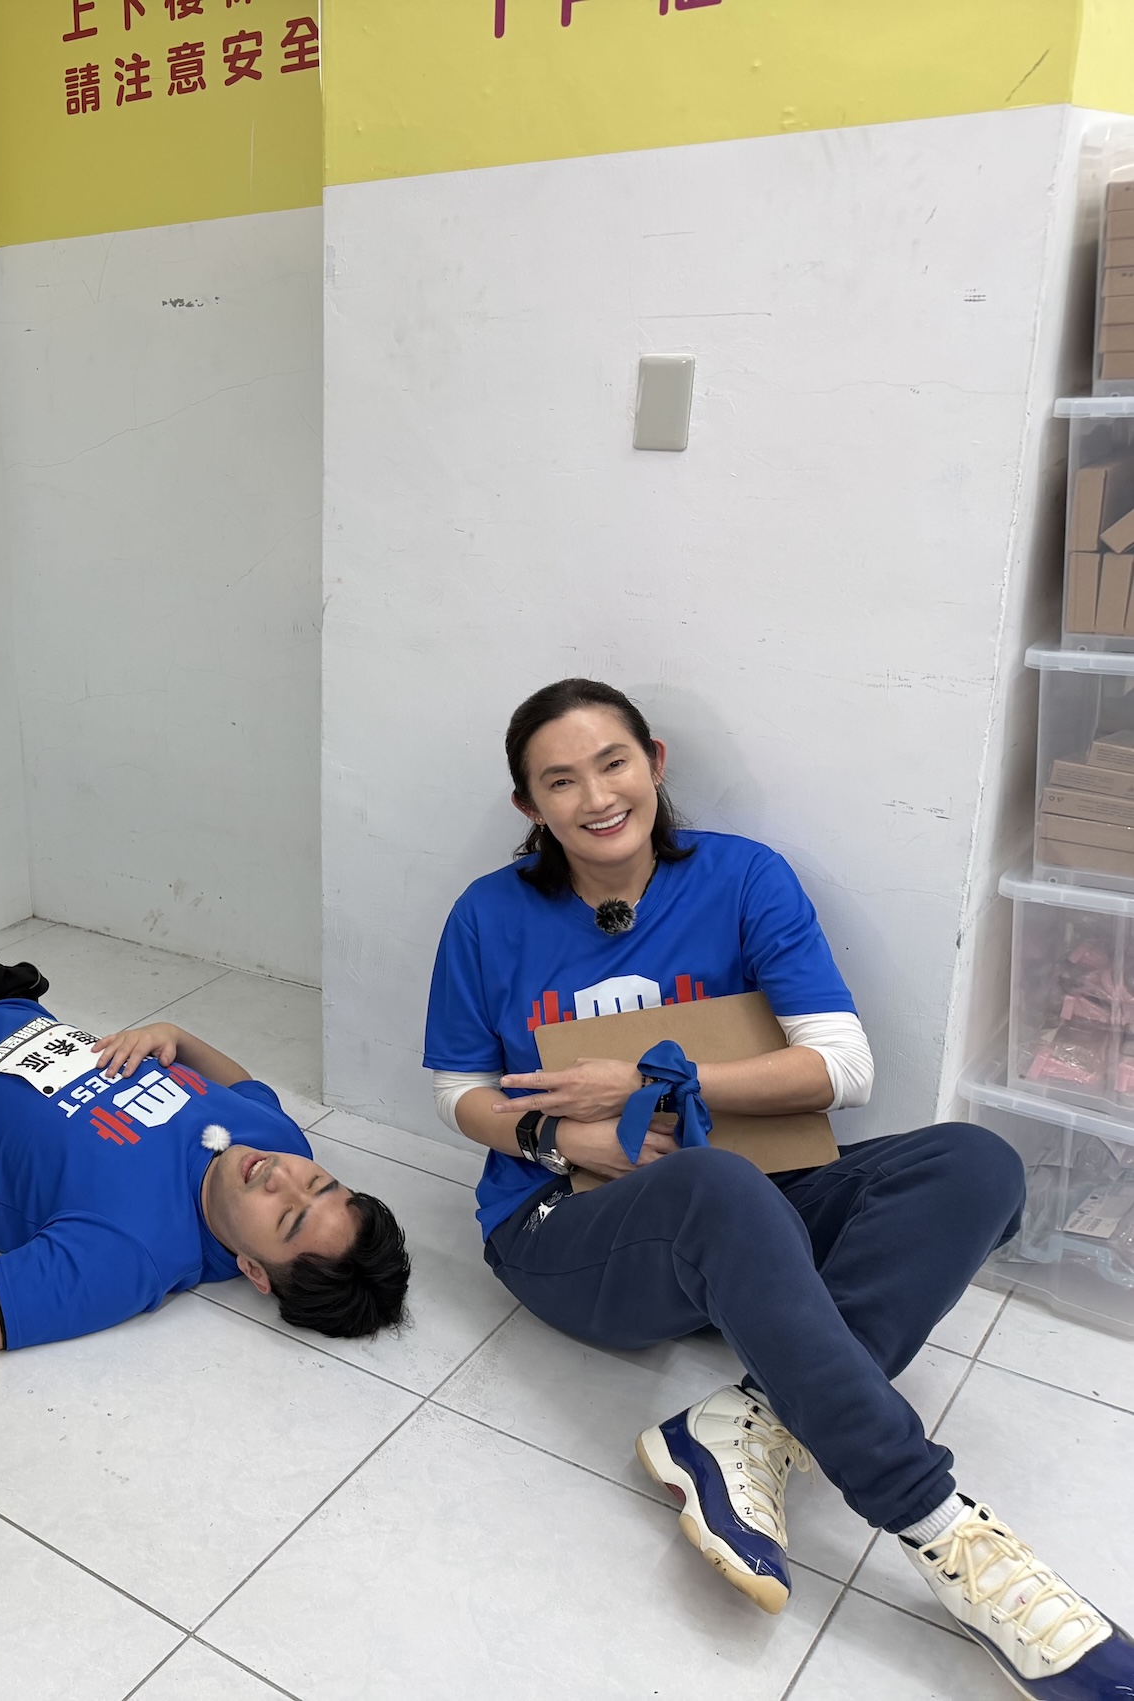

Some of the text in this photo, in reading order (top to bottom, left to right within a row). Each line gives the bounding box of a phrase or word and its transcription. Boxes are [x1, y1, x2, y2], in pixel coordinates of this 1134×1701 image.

[63, 0, 252, 42] 上下
[65, 17, 320, 115] 請注意安全
